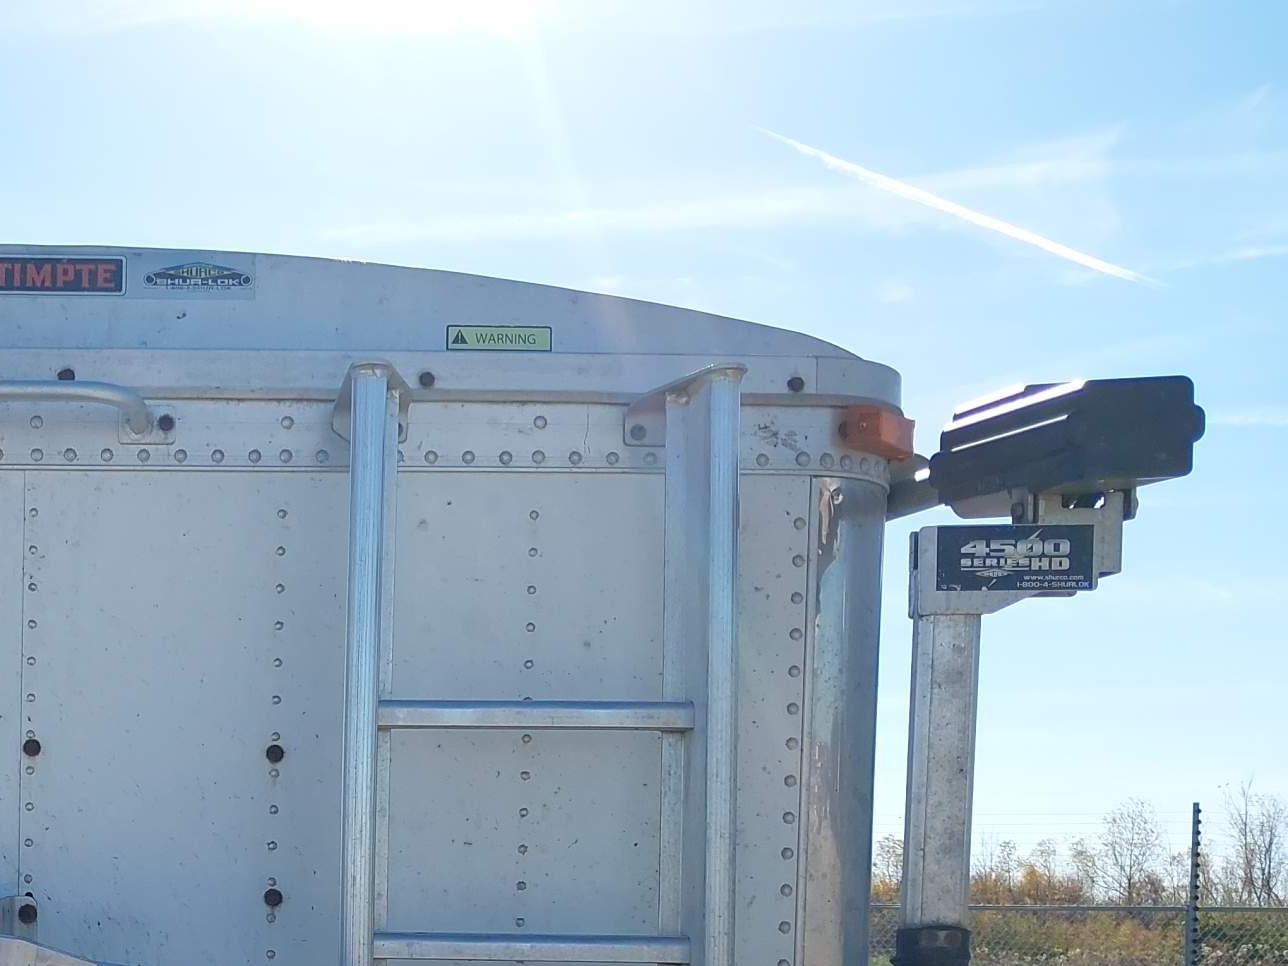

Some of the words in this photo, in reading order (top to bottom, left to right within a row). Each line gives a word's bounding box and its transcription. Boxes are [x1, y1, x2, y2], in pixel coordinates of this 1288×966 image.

[475, 332, 537, 346] WARNING
[960, 539, 1071, 557] 4500
[960, 557, 1030, 568] SERIES
[1031, 557, 1071, 571] HD
